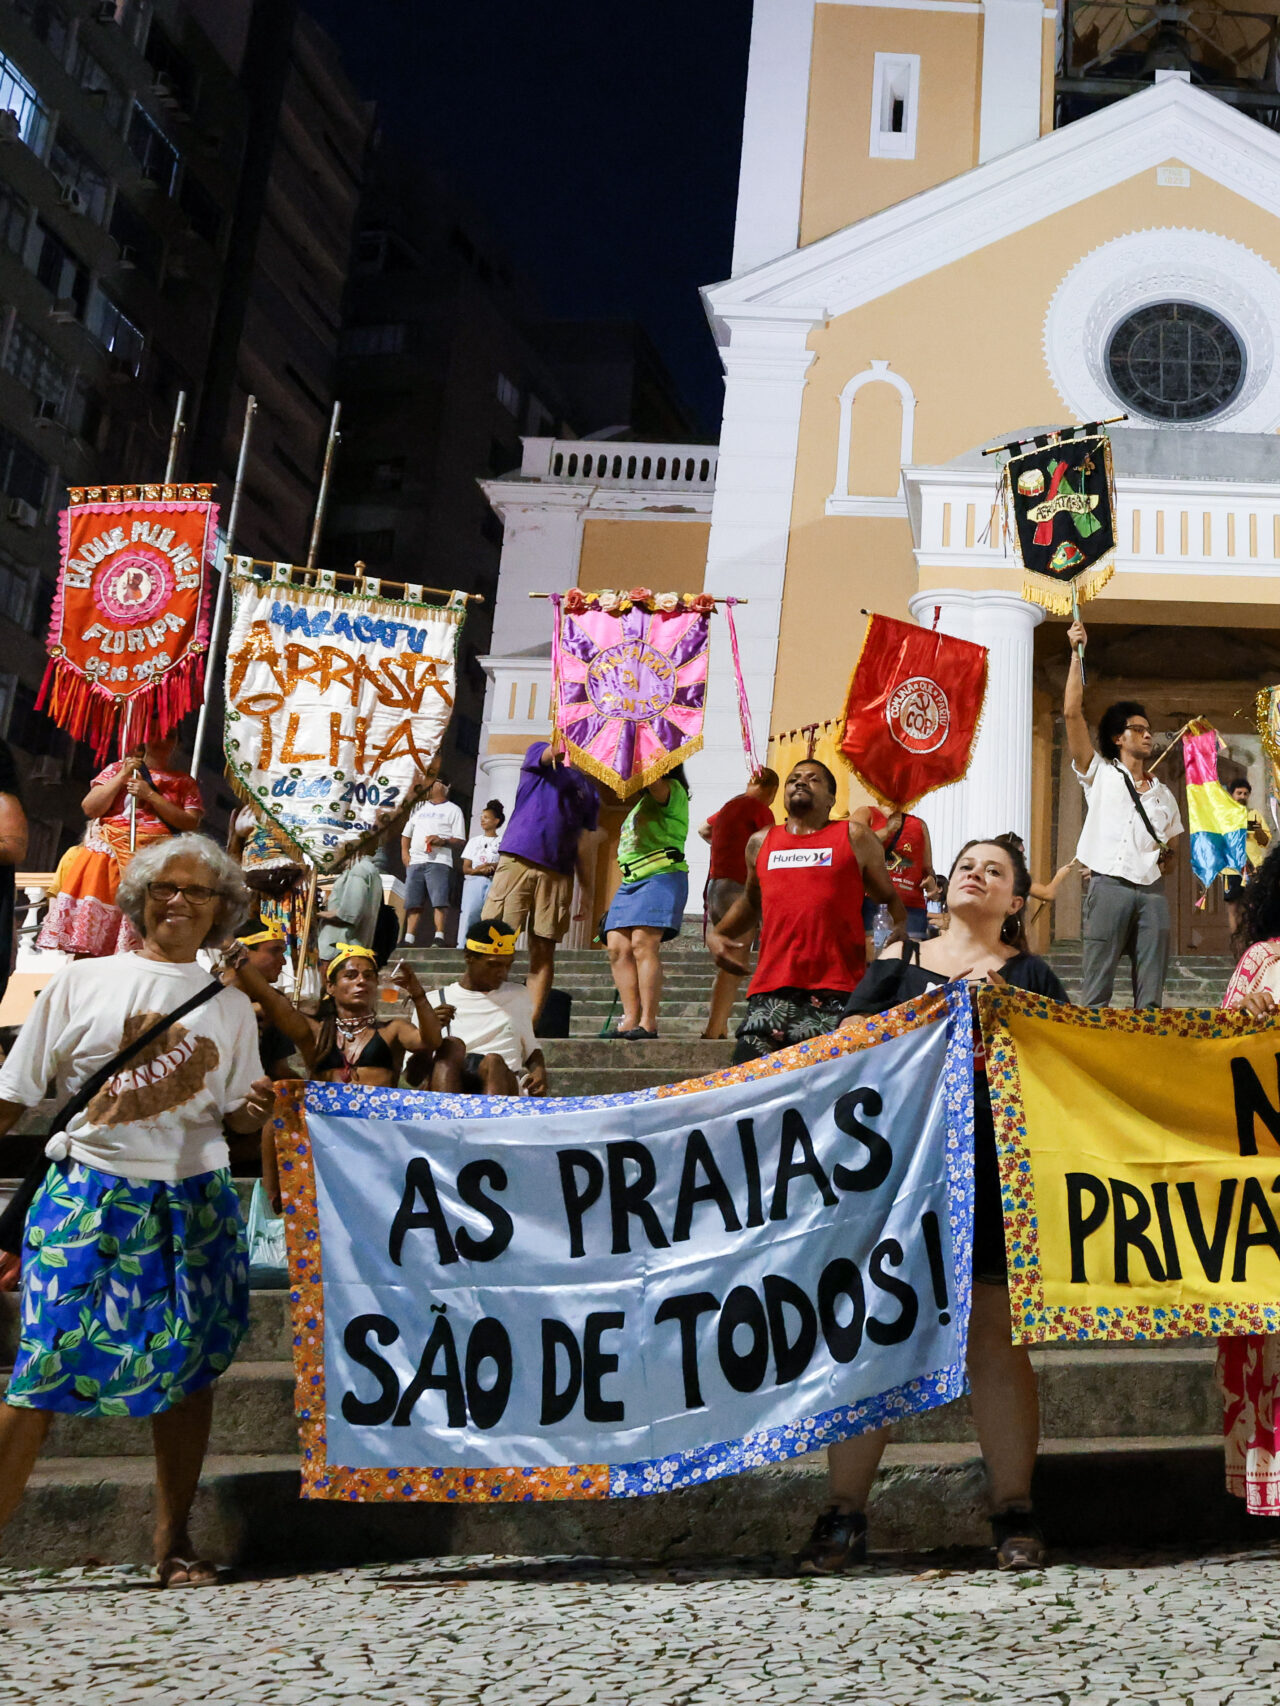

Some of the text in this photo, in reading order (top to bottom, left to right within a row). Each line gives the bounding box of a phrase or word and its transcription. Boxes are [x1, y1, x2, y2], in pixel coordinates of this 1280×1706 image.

[81, 612, 187, 655] FLORIPA
[270, 601, 428, 653] MARACATU
[228, 620, 454, 713] ARRASTA
[623, 670, 640, 692] DA
[890, 683, 916, 719] COMUNA
[339, 781, 400, 808] 2002
[773, 853, 811, 863] Hurley
[388, 1086, 894, 1267] AS PRAIAS
[341, 1211, 952, 1431] SÃO DE TODOS!
